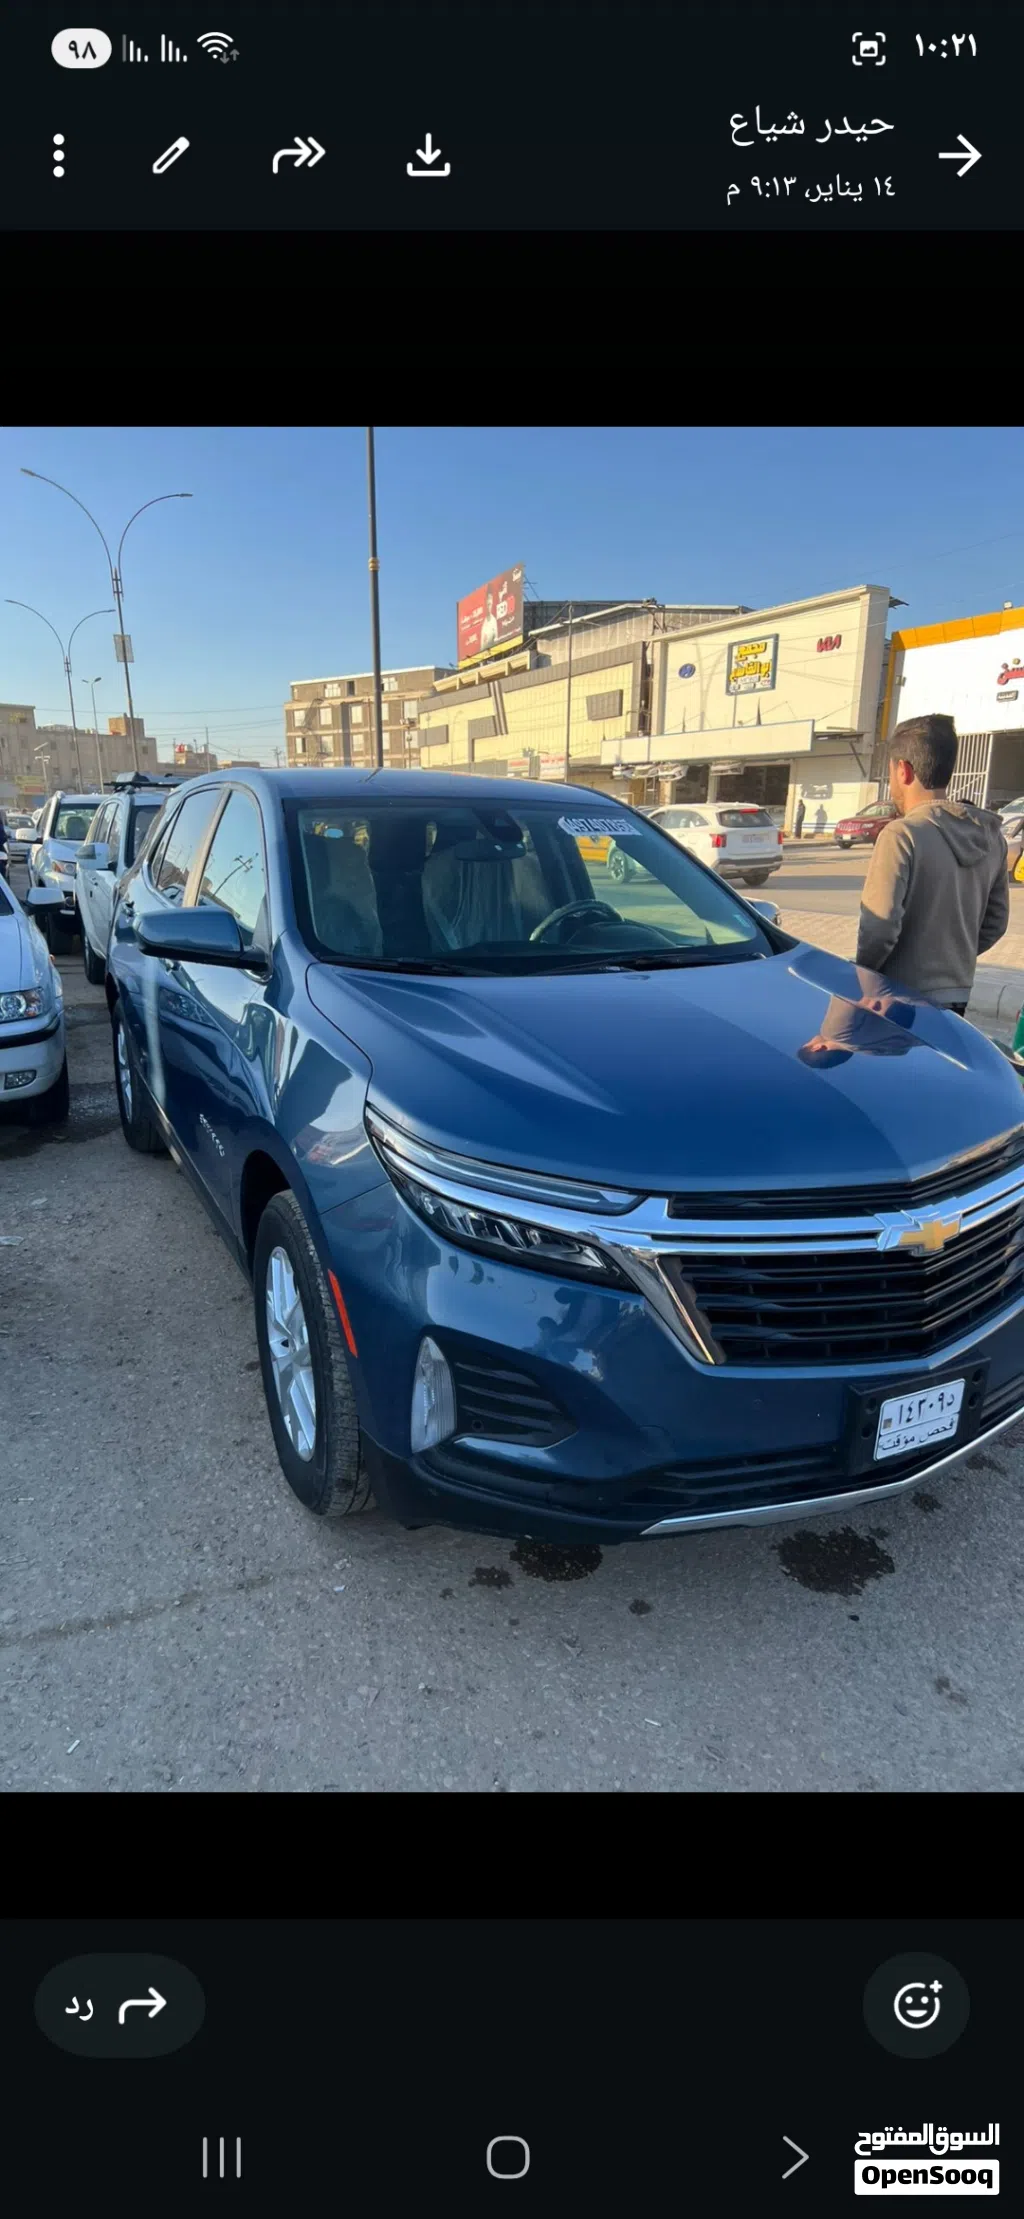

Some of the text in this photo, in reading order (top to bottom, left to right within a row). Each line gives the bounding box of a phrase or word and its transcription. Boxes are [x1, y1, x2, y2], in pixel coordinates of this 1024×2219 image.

[68, 40, 97, 59] ٩٨
[915, 33, 977, 59] ١٠:٢١
[729, 104, 895, 147] حيدر شياع
[726, 173, 896, 206] ١٤ يناير، ٩:١٣ م
[919, 1417, 956, 1443] فحص
[64, 1996, 94, 2022] رد
